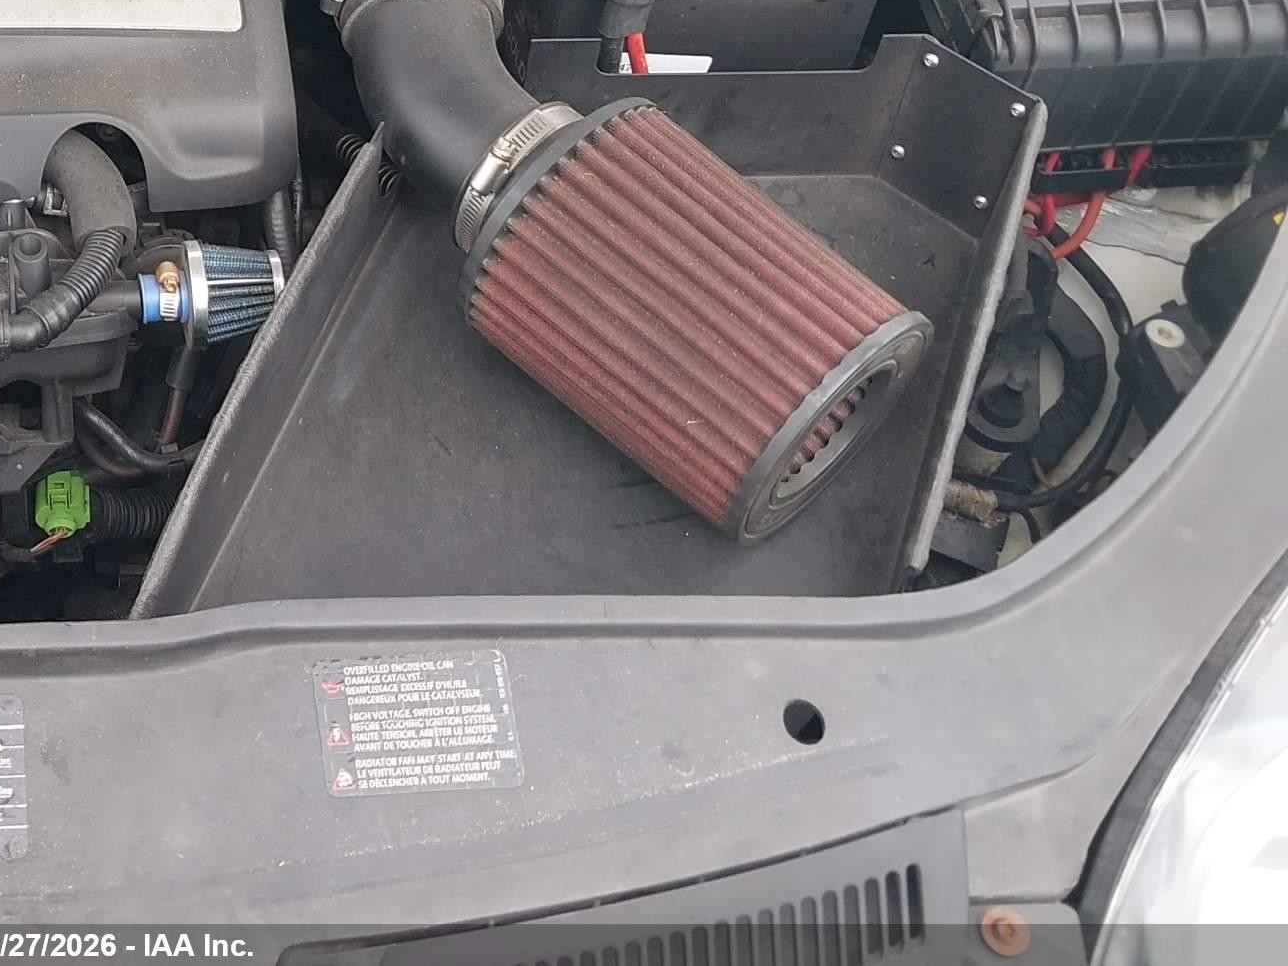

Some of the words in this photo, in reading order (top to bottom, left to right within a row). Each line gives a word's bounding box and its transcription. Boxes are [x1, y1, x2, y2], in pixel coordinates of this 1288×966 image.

[343, 664, 389, 675] OVERFILLED
[436, 660, 454, 670] CAN
[344, 674, 381, 685] DAMAGE
[382, 672, 424, 683] CATALYST.
[345, 684, 399, 695] REMPLISSAGE
[400, 681, 434, 691] EXCESSIF
[435, 679, 467, 689] D'HUILE
[347, 694, 396, 705] DANGEREUX
[397, 692, 420, 702] POUR
[421, 691, 430, 701] LE
[431, 688, 484, 700] CATALYSEUR.
[412, 707, 444, 718] SWITCH
[445, 706, 460, 715] OFF
[461, 703, 491, 714] ENGINE
[350, 720, 381, 731] BEFORE
[382, 717, 425, 729] TOUCHING
[425, 715, 462, 726] IGNITION
[463, 713, 497, 724] SYSTEM.
[352, 732, 379, 742] HAUTE
[453, 726, 464, 735] LE
[464, 724, 498, 734] MOTEUR
[354, 742, 381, 752] AVANT
[383, 740, 395, 750] DE
[396, 738, 432, 749] TOUCHER
[355, 757, 397, 768] RADIATOR
[398, 755, 416, 765] FAN
[416, 754, 435, 764] MAY
[437, 752, 461, 763] START
[464, 752, 475, 761] AT
[476, 750, 493, 760] ANY
[494, 748, 517, 759] TIME.
[356, 769, 367, 778] LE
[367, 766, 421, 778] VENTILATEUR
[422, 764, 433, 774] DE
[434, 761, 480, 773] RADIATEUR
[481, 760, 501, 770] PEUT
[358, 779, 368, 789] SE
[428, 774, 450, 784] TOUT
[452, 772, 490, 783] MOMENT.
